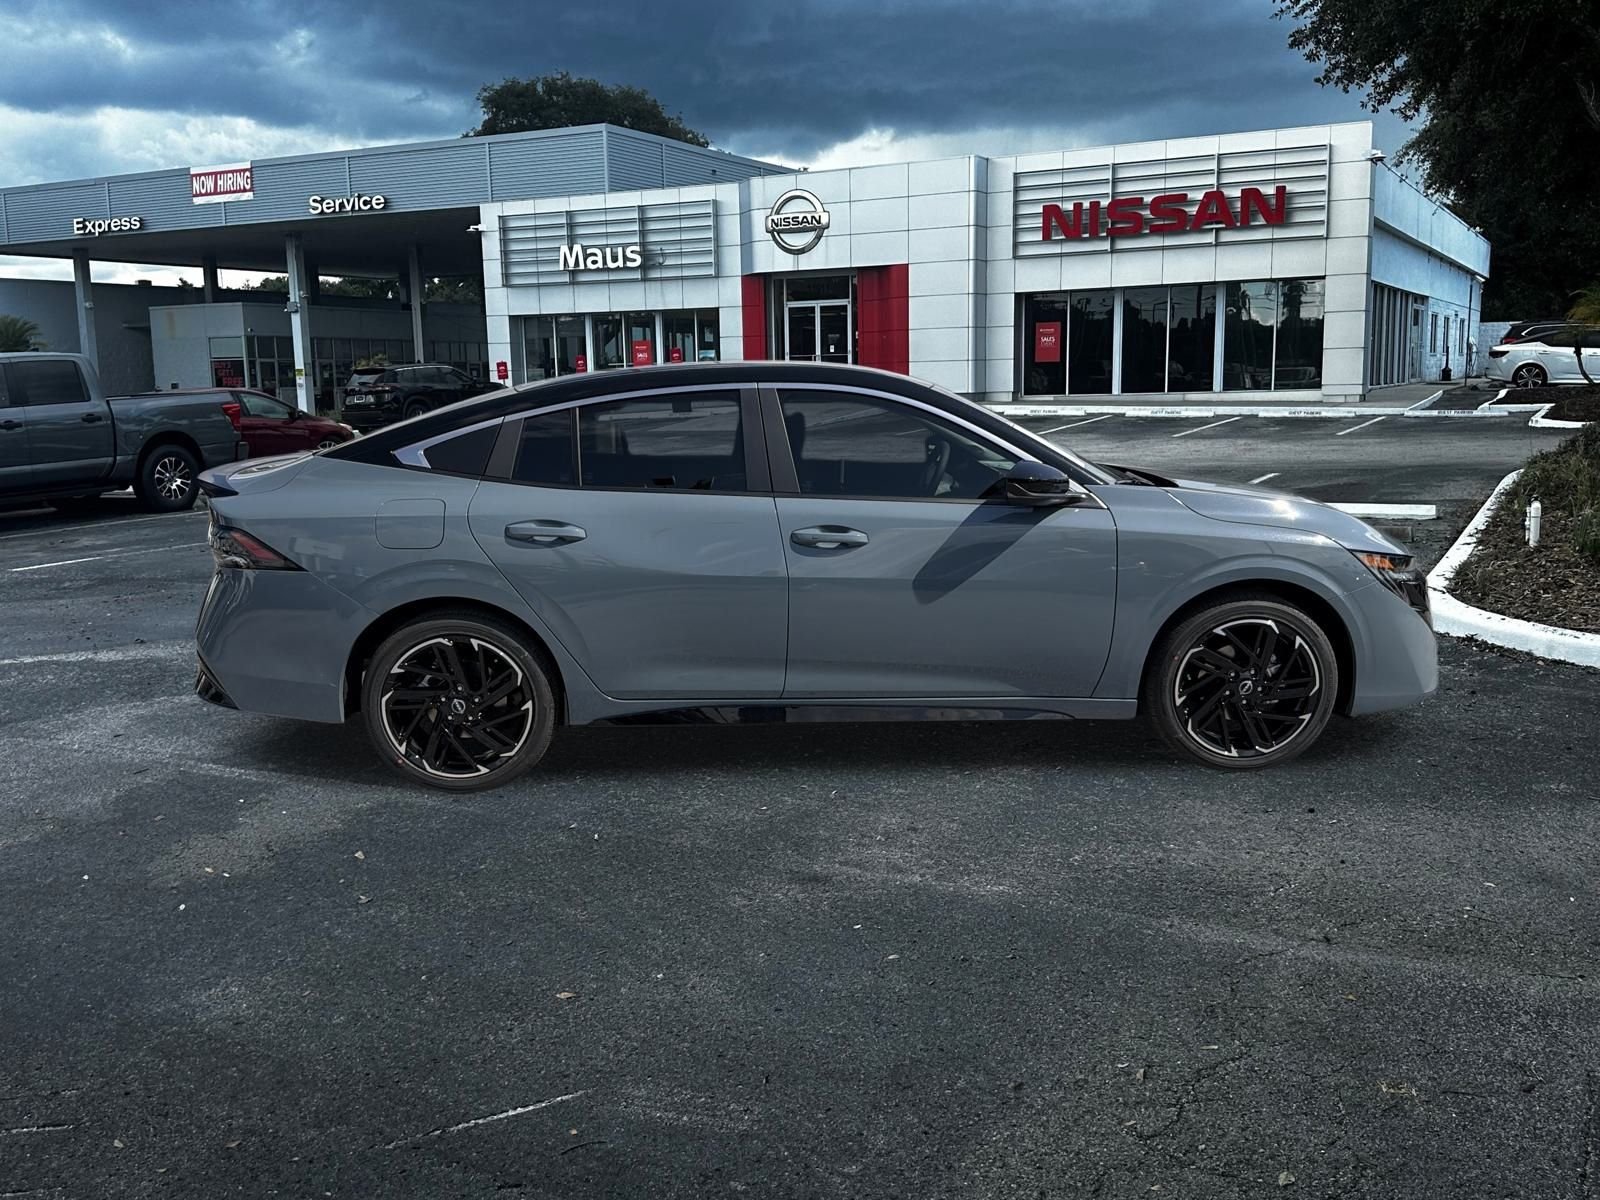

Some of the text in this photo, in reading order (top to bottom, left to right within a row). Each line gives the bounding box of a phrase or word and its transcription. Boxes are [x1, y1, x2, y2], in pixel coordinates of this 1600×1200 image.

[192, 170, 252, 195] NOW HIRING
[308, 193, 386, 215] Service
[1042, 185, 1287, 241] NISSAN
[72, 215, 142, 236] Express
[770, 214, 823, 230] NISSAN
[559, 243, 642, 271] Maus
[222, 377, 244, 387] FREE
